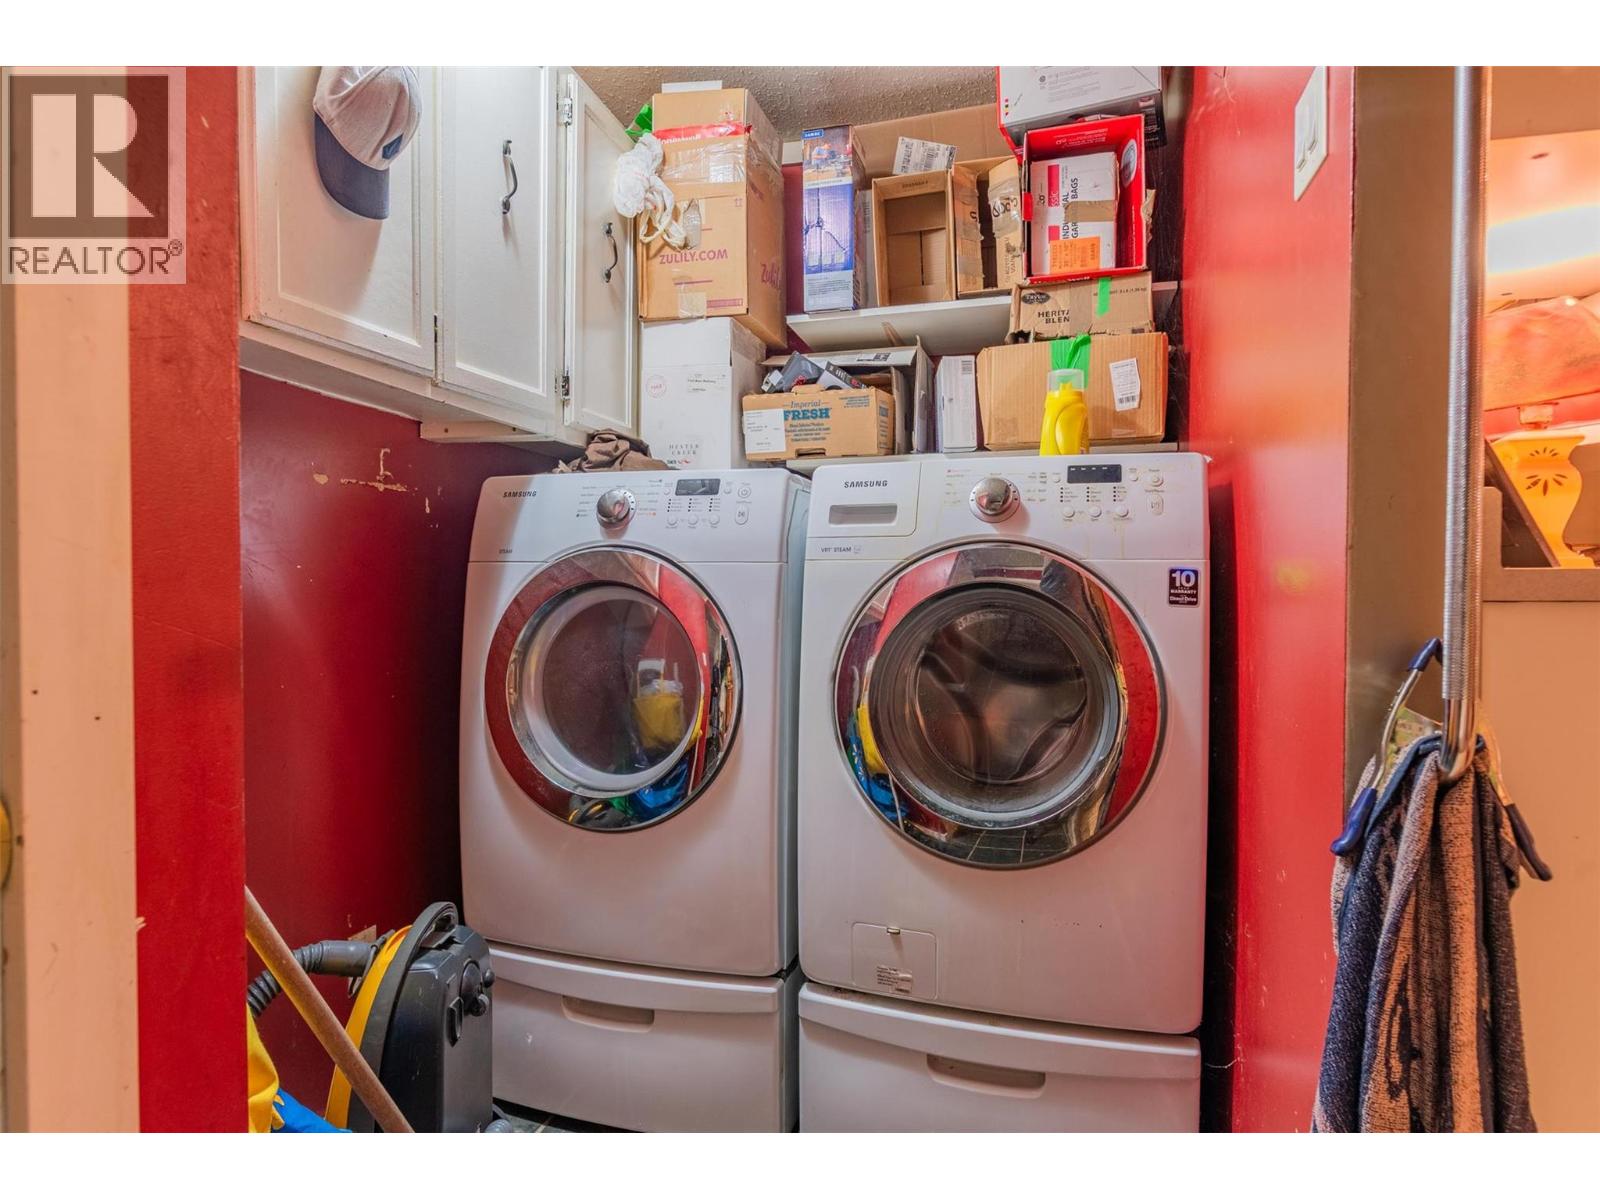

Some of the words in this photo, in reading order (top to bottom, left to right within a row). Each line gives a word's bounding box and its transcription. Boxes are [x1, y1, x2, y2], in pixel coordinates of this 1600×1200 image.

[1070, 177, 1079, 200] BAGS
[659, 248, 729, 265] ZULILY.COM
[790, 400, 822, 409] Imperial
[784, 407, 831, 421] FRESH
[843, 480, 888, 489] SAMSUNG
[503, 490, 537, 499] SAMSUNG
[1171, 570, 1196, 588] 10
